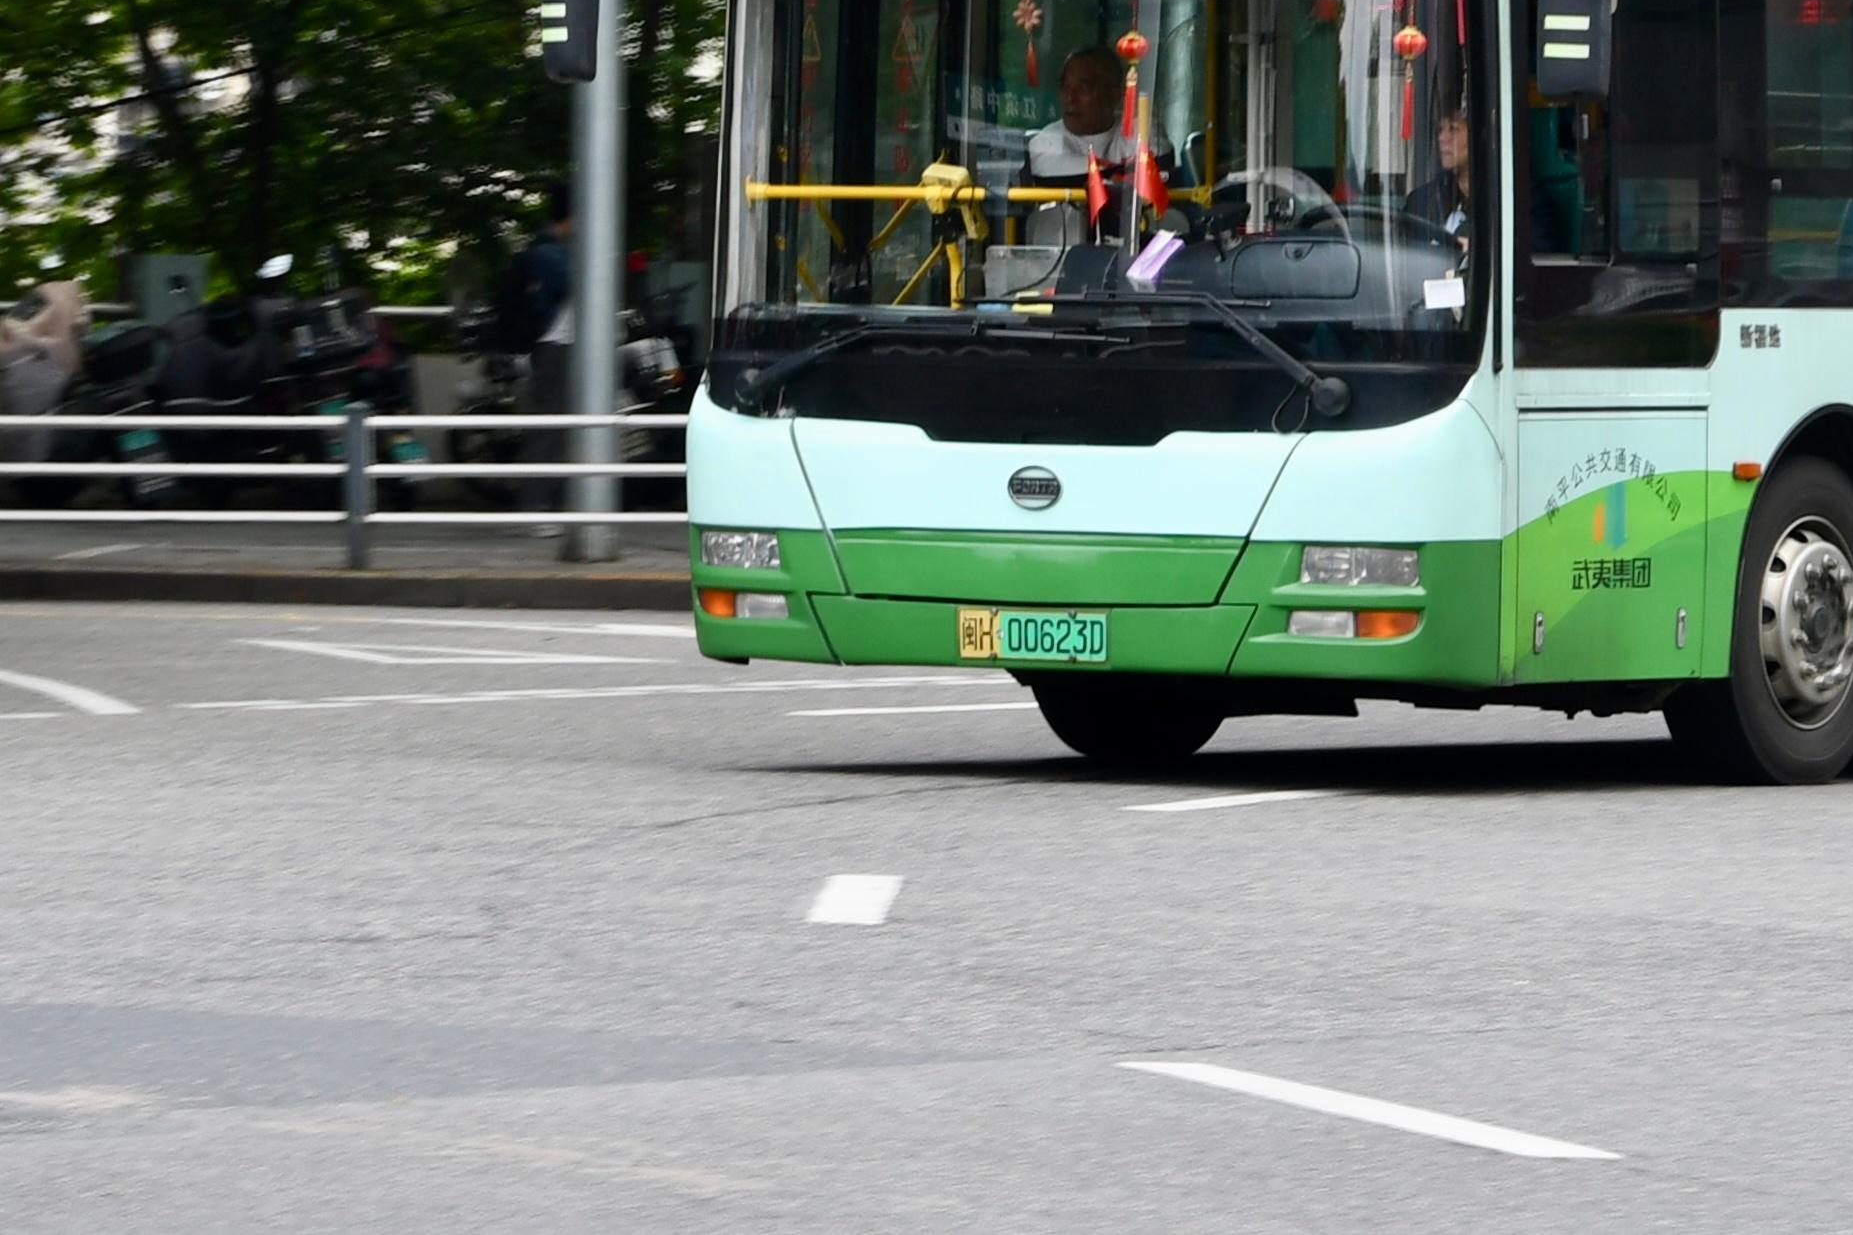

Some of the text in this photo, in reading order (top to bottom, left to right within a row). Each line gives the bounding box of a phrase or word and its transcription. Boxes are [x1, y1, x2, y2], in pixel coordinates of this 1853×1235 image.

[1544, 447, 1682, 525] 南平公共交通有限公司
[1571, 557, 1652, 590] 武夷集团
